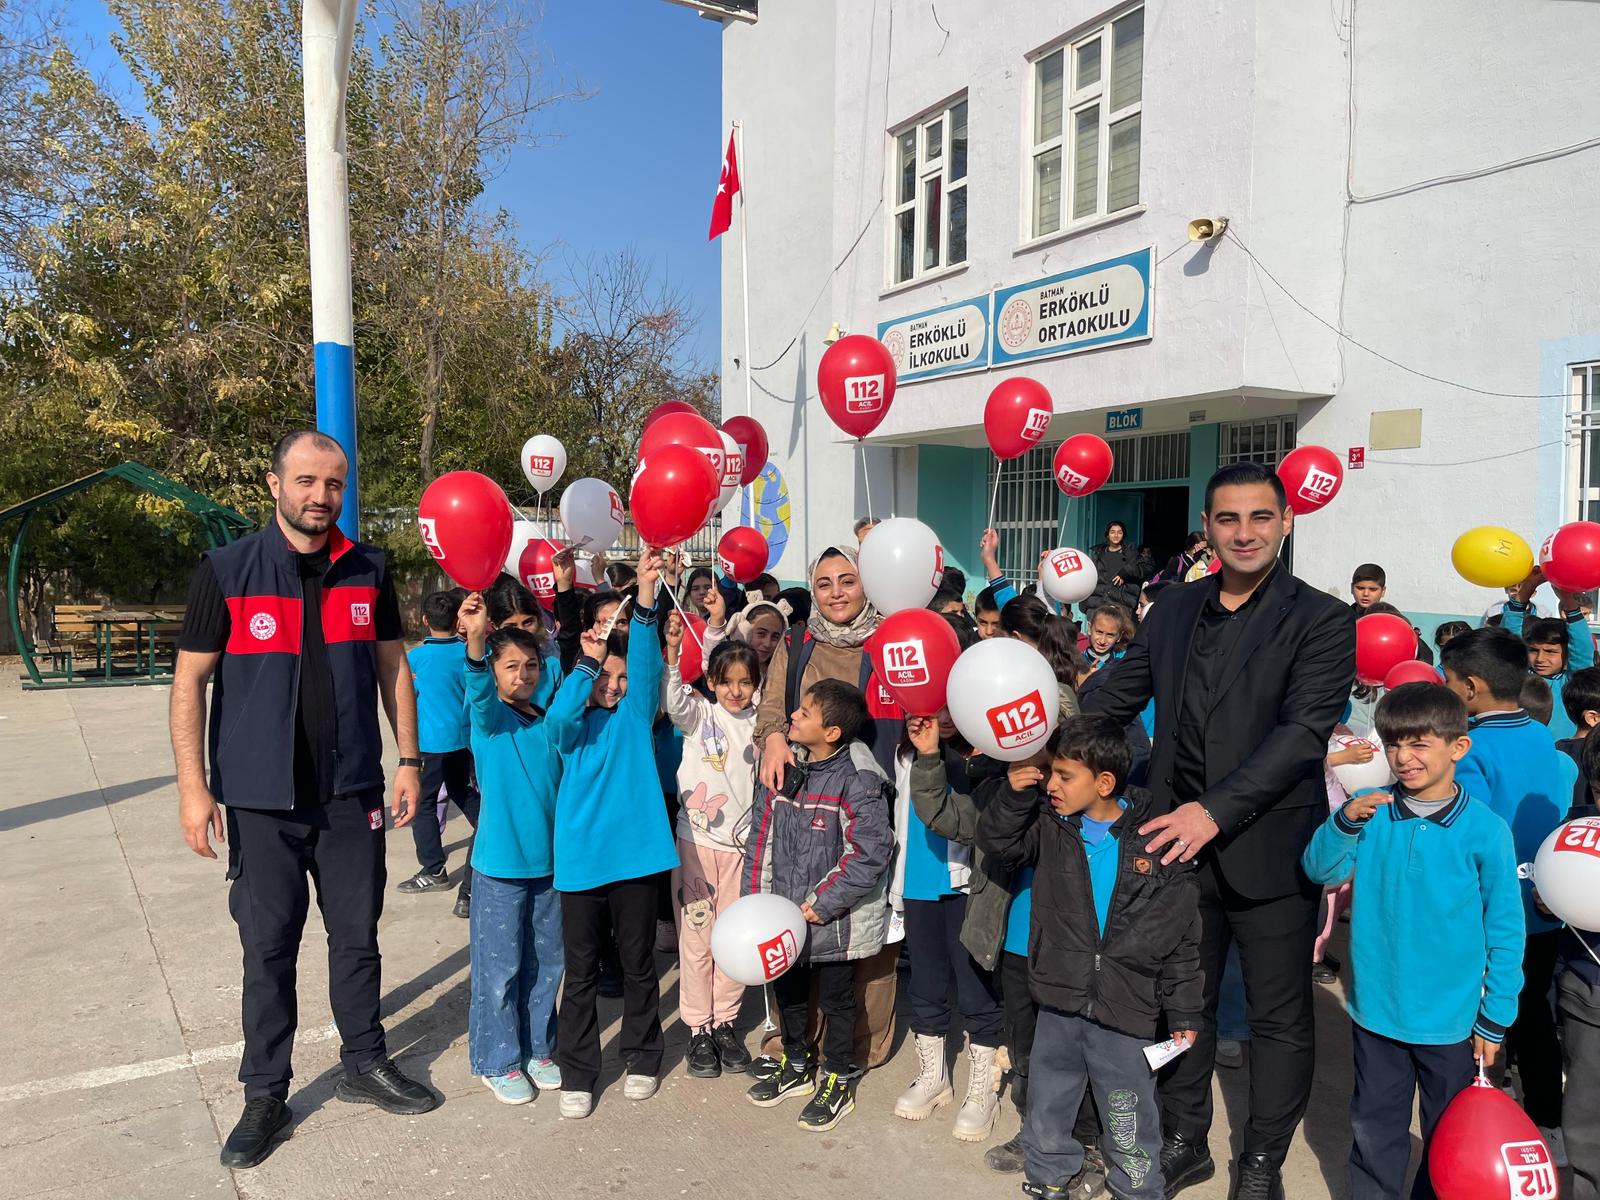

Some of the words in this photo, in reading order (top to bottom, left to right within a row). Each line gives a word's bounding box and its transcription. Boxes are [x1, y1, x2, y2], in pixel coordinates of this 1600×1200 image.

[1039, 283, 1109, 320] ERKÖKLÜ
[1040, 286, 1064, 300] BATMAN
[909, 318, 966, 349] ERKÖKLÜ
[1038, 308, 1130, 343] ORTAOKULU
[909, 343, 970, 369] İLKOKULU
[851, 380, 879, 398] 112
[1032, 413, 1050, 430] 112
[1109, 414, 1138, 429] BLOK
[533, 457, 551, 469] 112
[726, 457, 741, 474] 112
[1063, 470, 1082, 488] 112
[1310, 473, 1333, 493] 112
[1056, 557, 1080, 573] 112
[531, 576, 551, 589] 112
[354, 606, 367, 616] 112
[888, 645, 919, 668] 112
[996, 701, 1040, 734] 112
[765, 943, 786, 975] 112
[1517, 1168, 1553, 1197] 112
